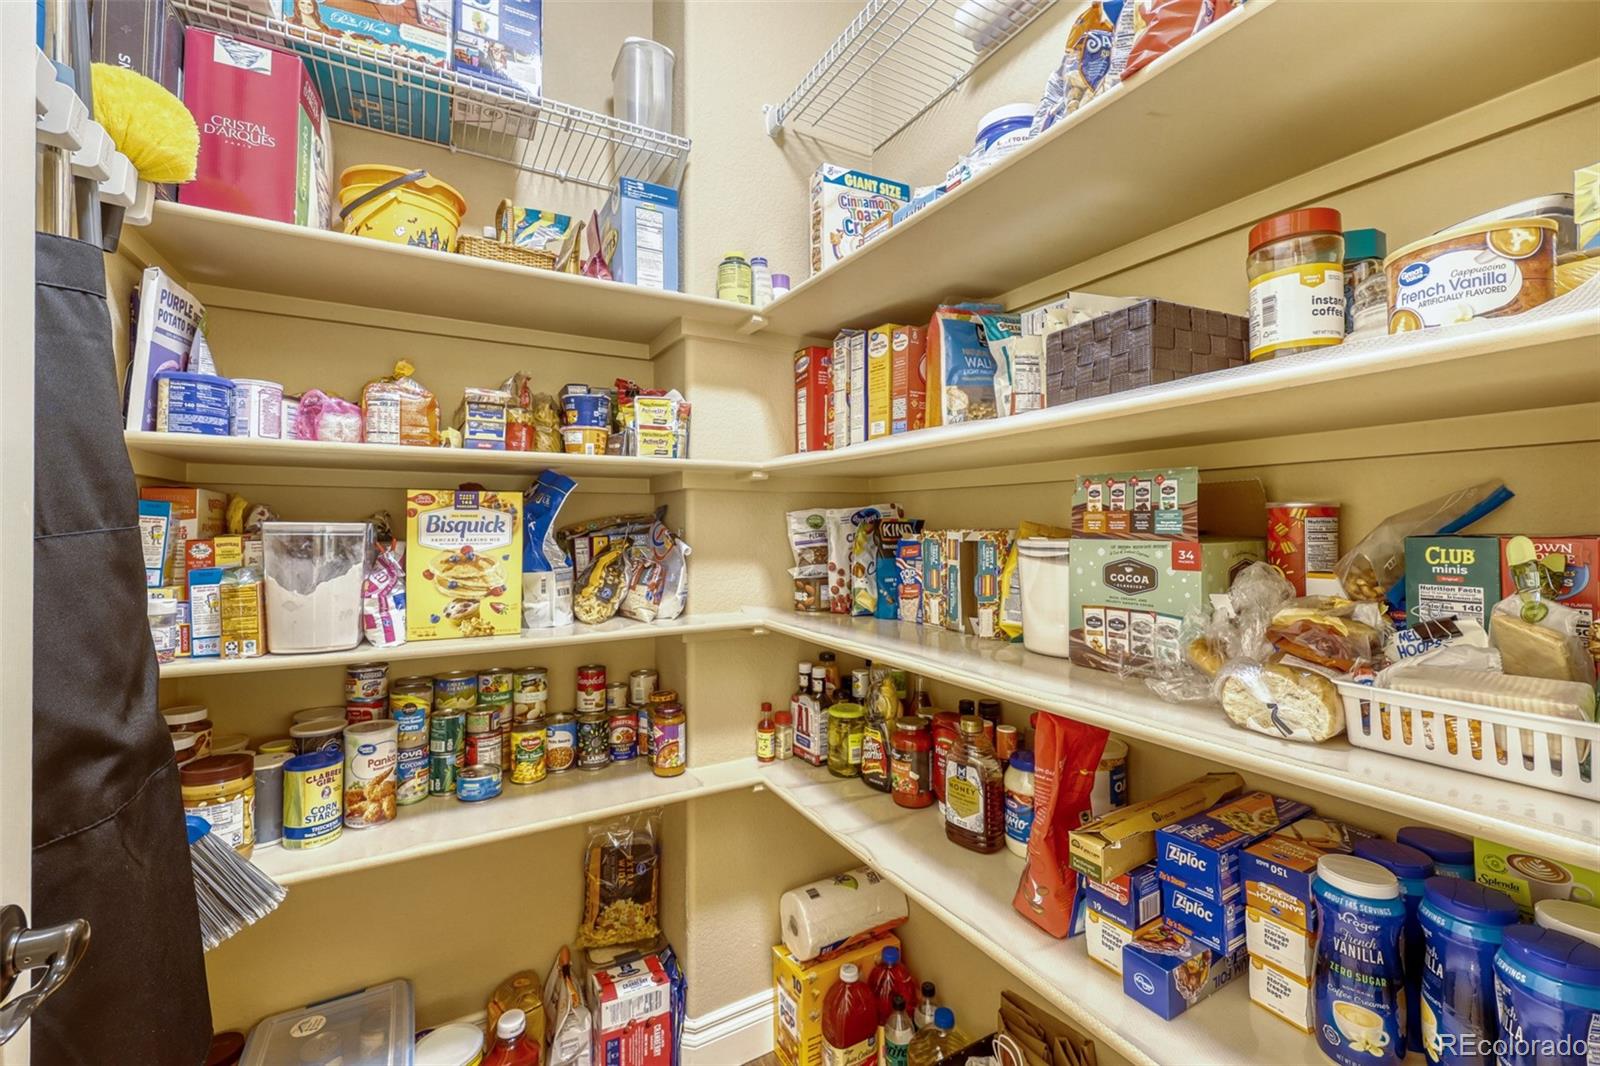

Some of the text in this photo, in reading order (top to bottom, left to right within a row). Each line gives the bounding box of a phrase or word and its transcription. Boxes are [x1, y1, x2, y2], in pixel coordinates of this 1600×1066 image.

[211, 114, 268, 135] CRISTAL
[204, 122, 276, 148] D'ARQUES
[844, 173, 902, 199] GIANT SIZE
[840, 194, 891, 210] Cinnamon
[850, 209, 882, 223] Toast
[1450, 263, 1506, 279] Cappuccino
[1401, 271, 1508, 306] French Vanilla
[1417, 285, 1508, 309] ARTIFICIALLY FLAVORED
[160, 289, 193, 319] PURPLE
[1312, 306, 1343, 317] coffee
[158, 308, 186, 332] POTATO
[426, 514, 505, 538] Bisquick
[882, 523, 914, 538] KIND
[1178, 550, 1195, 560] 34
[1425, 546, 1476, 565] CLUB
[1534, 543, 1573, 554] OWN
[1432, 564, 1468, 575] minis
[1109, 573, 1150, 585] COCOA
[1397, 639, 1442, 659] HOOPS
[316, 776, 336, 787] GIRL
[949, 782, 976, 795] HONEY
[304, 808, 340, 824] STARCH
[311, 801, 338, 815] CORN
[1169, 845, 1207, 872] Ziploc
[1271, 864, 1288, 878] 150
[1478, 873, 1520, 891] Splenda
[1176, 894, 1213, 922] Ziploc
[1323, 891, 1344, 905] ABOUT
[1360, 905, 1392, 916] SERVINGS
[1337, 911, 1381, 934] Kroger
[1102, 929, 1123, 944] storage
[1102, 934, 1122, 949] freezer
[1264, 928, 1290, 944] storage
[1264, 934, 1288, 948] freezer
[1339, 926, 1378, 950] French
[1101, 940, 1115, 952] bags
[1264, 940, 1280, 951] bags
[1333, 937, 1384, 965] VANILLA
[1329, 960, 1388, 987] ZERO SUGAR
[792, 975, 802, 994] 10
[1266, 976, 1292, 993] storage
[1266, 981, 1291, 998] freezer
[1266, 987, 1283, 1000] bags
[1327, 983, 1351, 1001] Coffee
[1354, 995, 1391, 1010] Creamer
